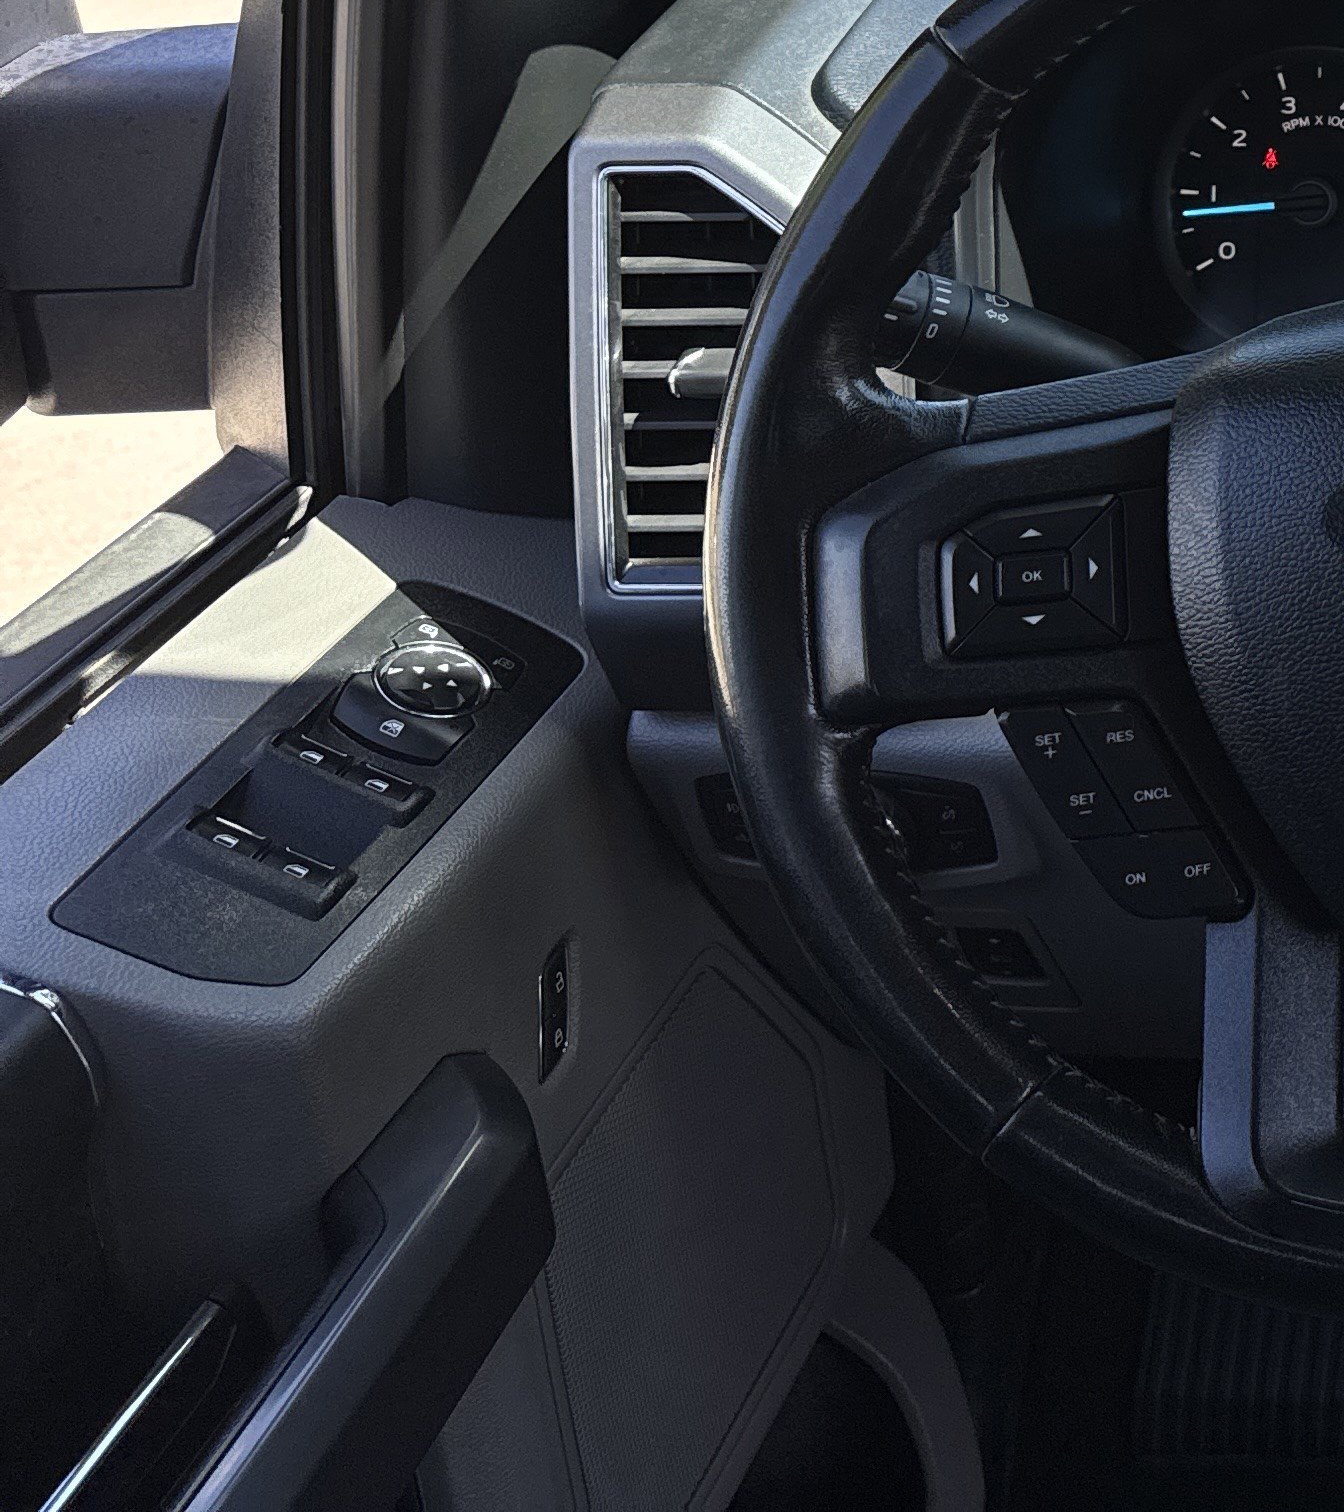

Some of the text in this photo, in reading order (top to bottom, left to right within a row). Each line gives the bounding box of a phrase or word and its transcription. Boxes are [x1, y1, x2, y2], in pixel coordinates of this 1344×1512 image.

[1281, 97, 1296, 114] 3
[1282, 115, 1310, 133] RPM
[1232, 129, 1247, 147] 2
[1211, 185, 1216, 202] 1
[1218, 241, 1236, 260] 0
[1021, 570, 1043, 583] OK
[1035, 732, 1062, 748] SET
[1106, 729, 1135, 744] RES
[1069, 792, 1096, 807] SET
[1133, 787, 1172, 803] CNCL
[1125, 872, 1146, 885] ON
[1184, 863, 1211, 878] OFF
